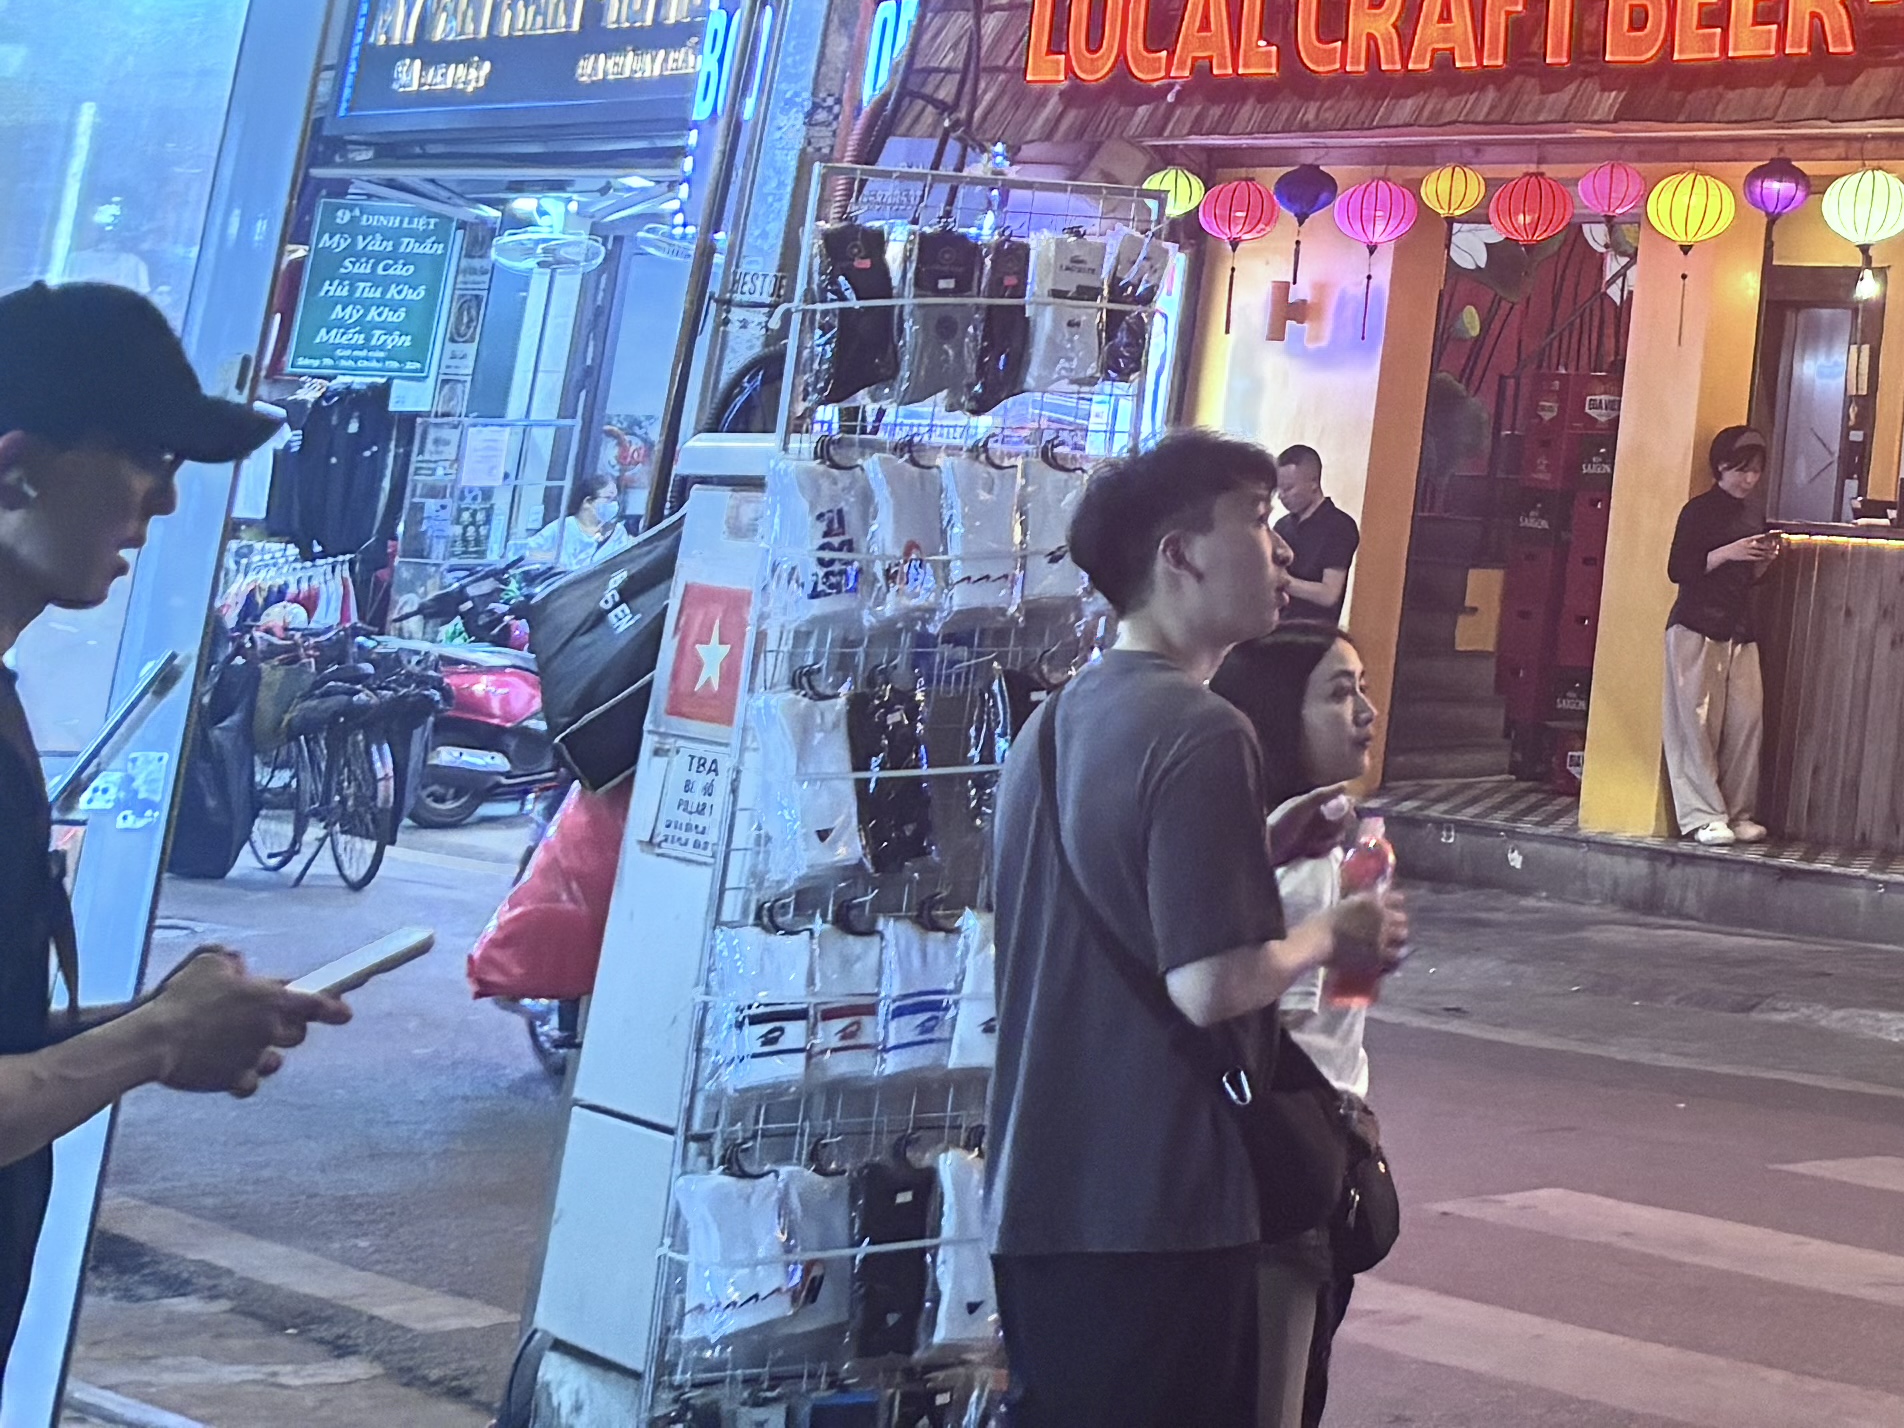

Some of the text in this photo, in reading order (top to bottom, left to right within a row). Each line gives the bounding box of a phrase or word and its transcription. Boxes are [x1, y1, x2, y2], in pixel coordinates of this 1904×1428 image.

[385, 283, 427, 301] Khô
[366, 305, 407, 322] Khô
[313, 326, 412, 349] Miến Trộn
[687, 754, 719, 776] TBA
